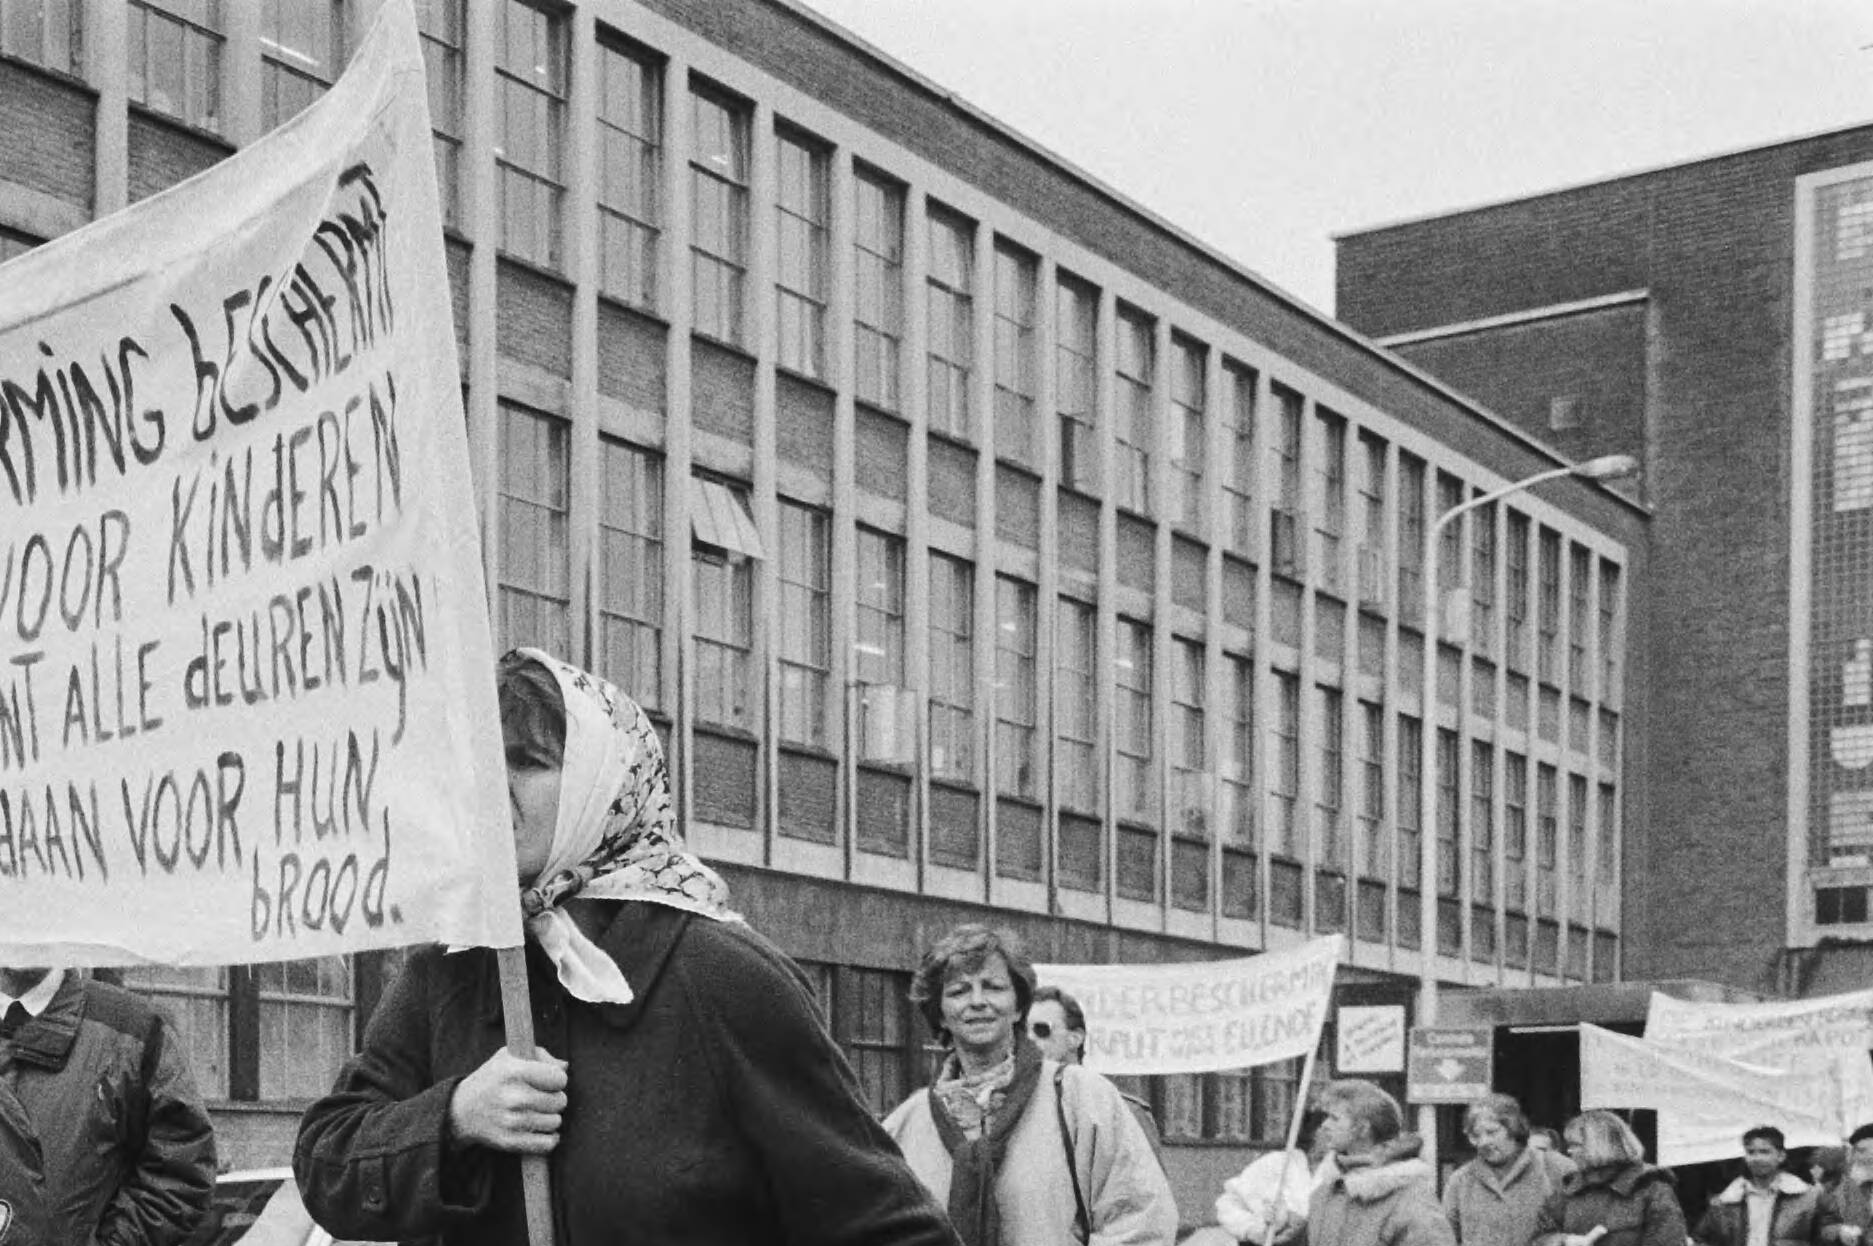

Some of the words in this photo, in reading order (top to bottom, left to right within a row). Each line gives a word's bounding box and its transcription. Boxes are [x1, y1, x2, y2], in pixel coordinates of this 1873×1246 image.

[62, 636, 163, 748] ALLE
[120, 751, 246, 877] VOOR
[274, 728, 380, 847] HUN
